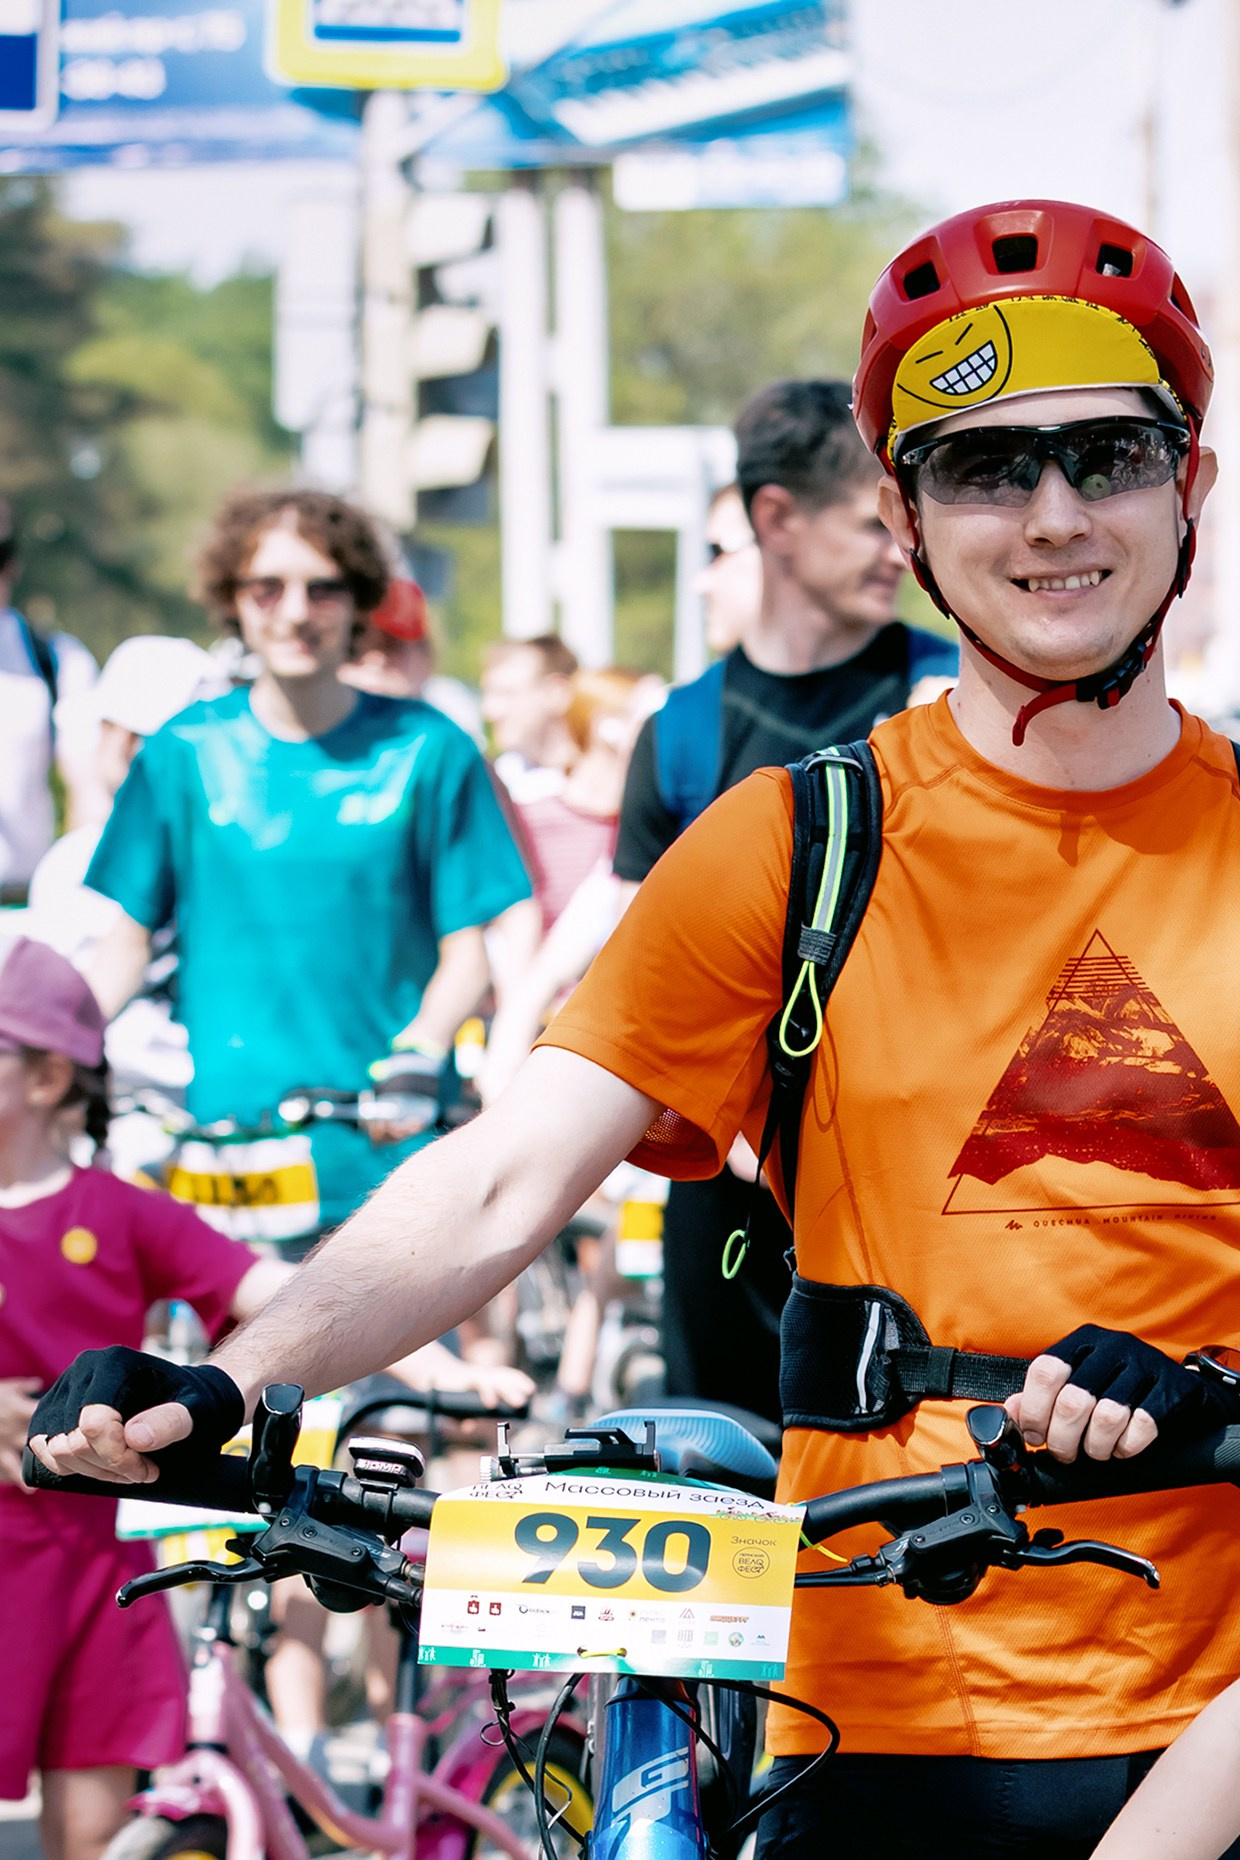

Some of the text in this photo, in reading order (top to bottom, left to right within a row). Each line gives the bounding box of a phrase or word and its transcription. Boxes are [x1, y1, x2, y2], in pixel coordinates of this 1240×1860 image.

[1033, 1218, 1091, 1228] QUECHUA
[545, 1480, 765, 1511] Массовый заезд
[730, 1535, 777, 1547] Значок
[514, 1511, 712, 1593] 930
